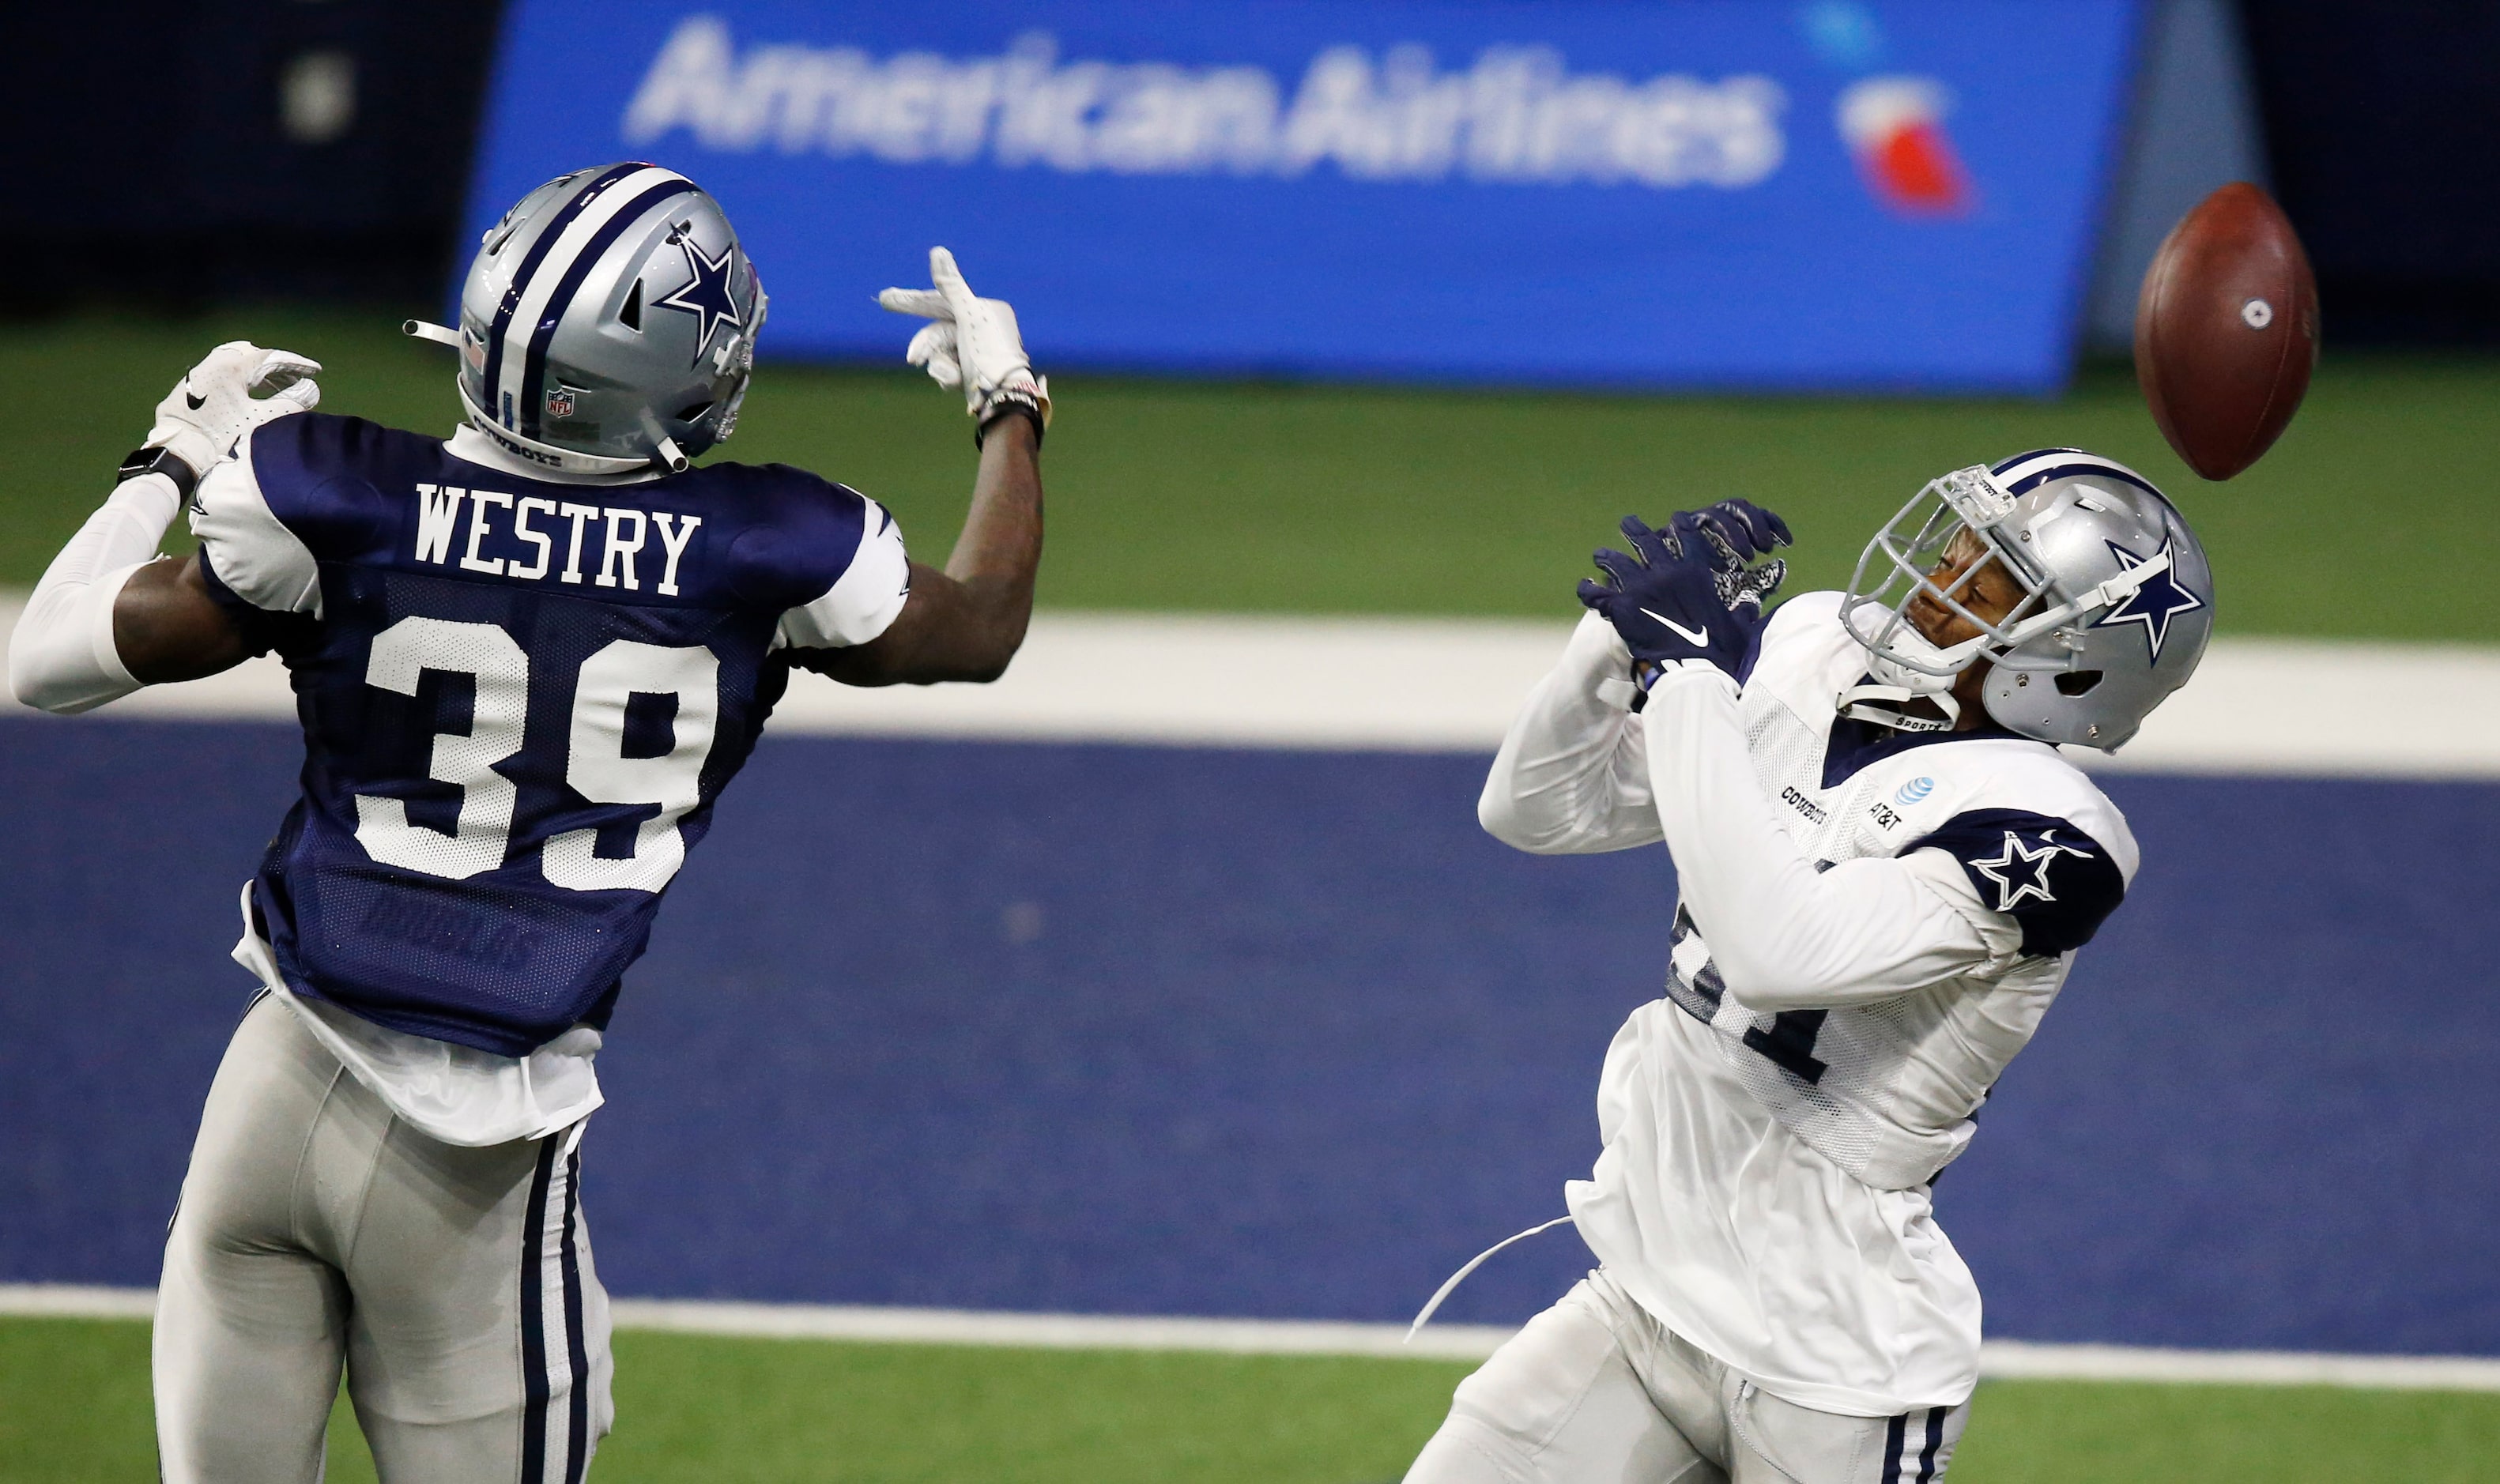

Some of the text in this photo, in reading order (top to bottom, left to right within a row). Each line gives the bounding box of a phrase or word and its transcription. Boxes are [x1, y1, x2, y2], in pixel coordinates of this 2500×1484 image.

[623, 13, 1785, 188] American Airlines
[549, 400, 571, 414] NFL
[415, 483, 702, 597] WESTRY
[353, 616, 720, 894] 39
[1782, 786, 1827, 826] COWBOYS
[1867, 802, 1902, 831] AT&T
